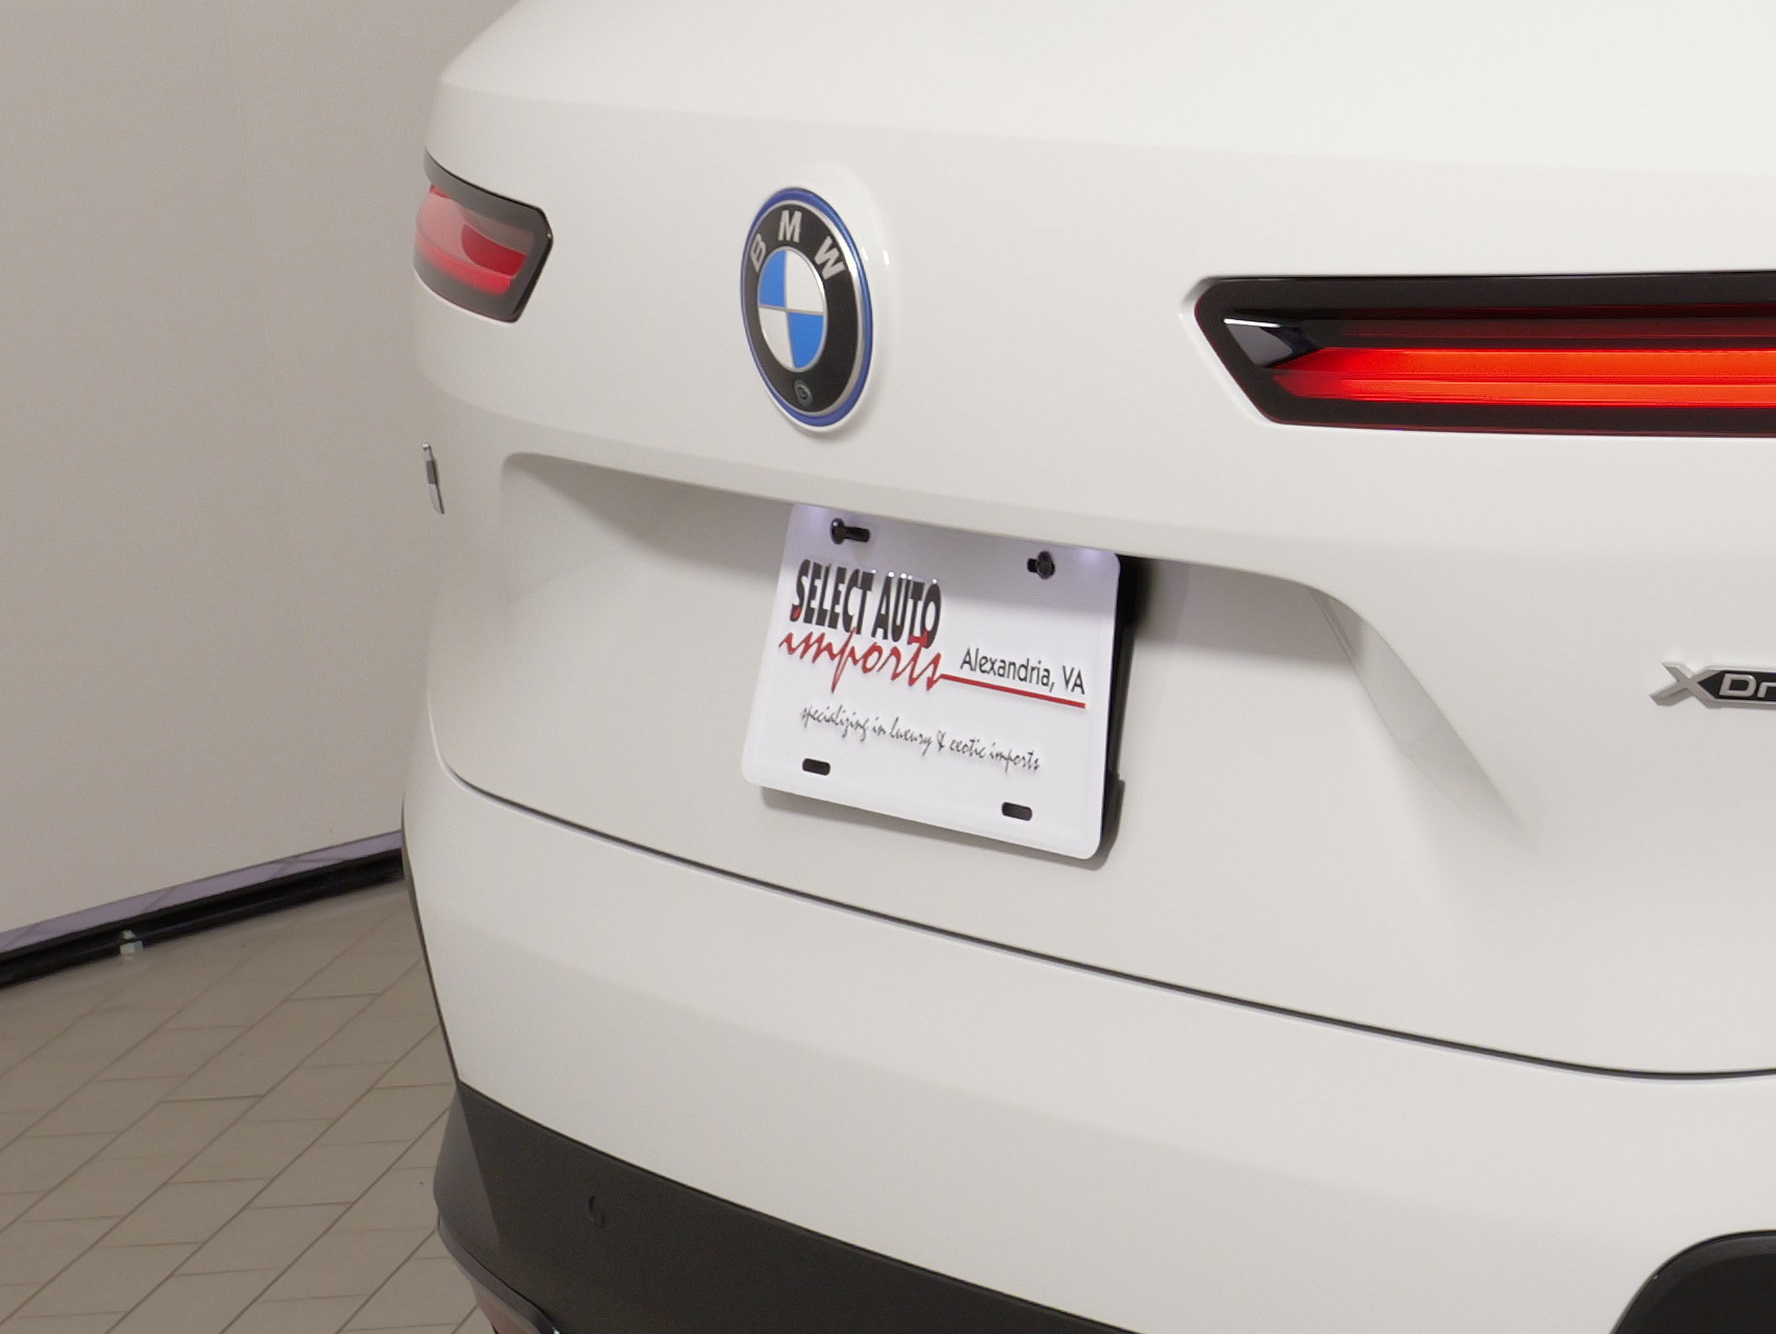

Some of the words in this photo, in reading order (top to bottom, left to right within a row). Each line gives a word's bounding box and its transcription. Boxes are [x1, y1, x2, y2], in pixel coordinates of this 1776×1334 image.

[750, 210, 846, 280] BMW
[789, 558, 875, 635] SELECT
[870, 571, 942, 650] AUTO
[778, 627, 942, 693] imports
[960, 646, 1054, 692] Alexandria,
[1062, 665, 1085, 695] VA
[872, 716, 887, 736] in
[989, 741, 1040, 772] imports
